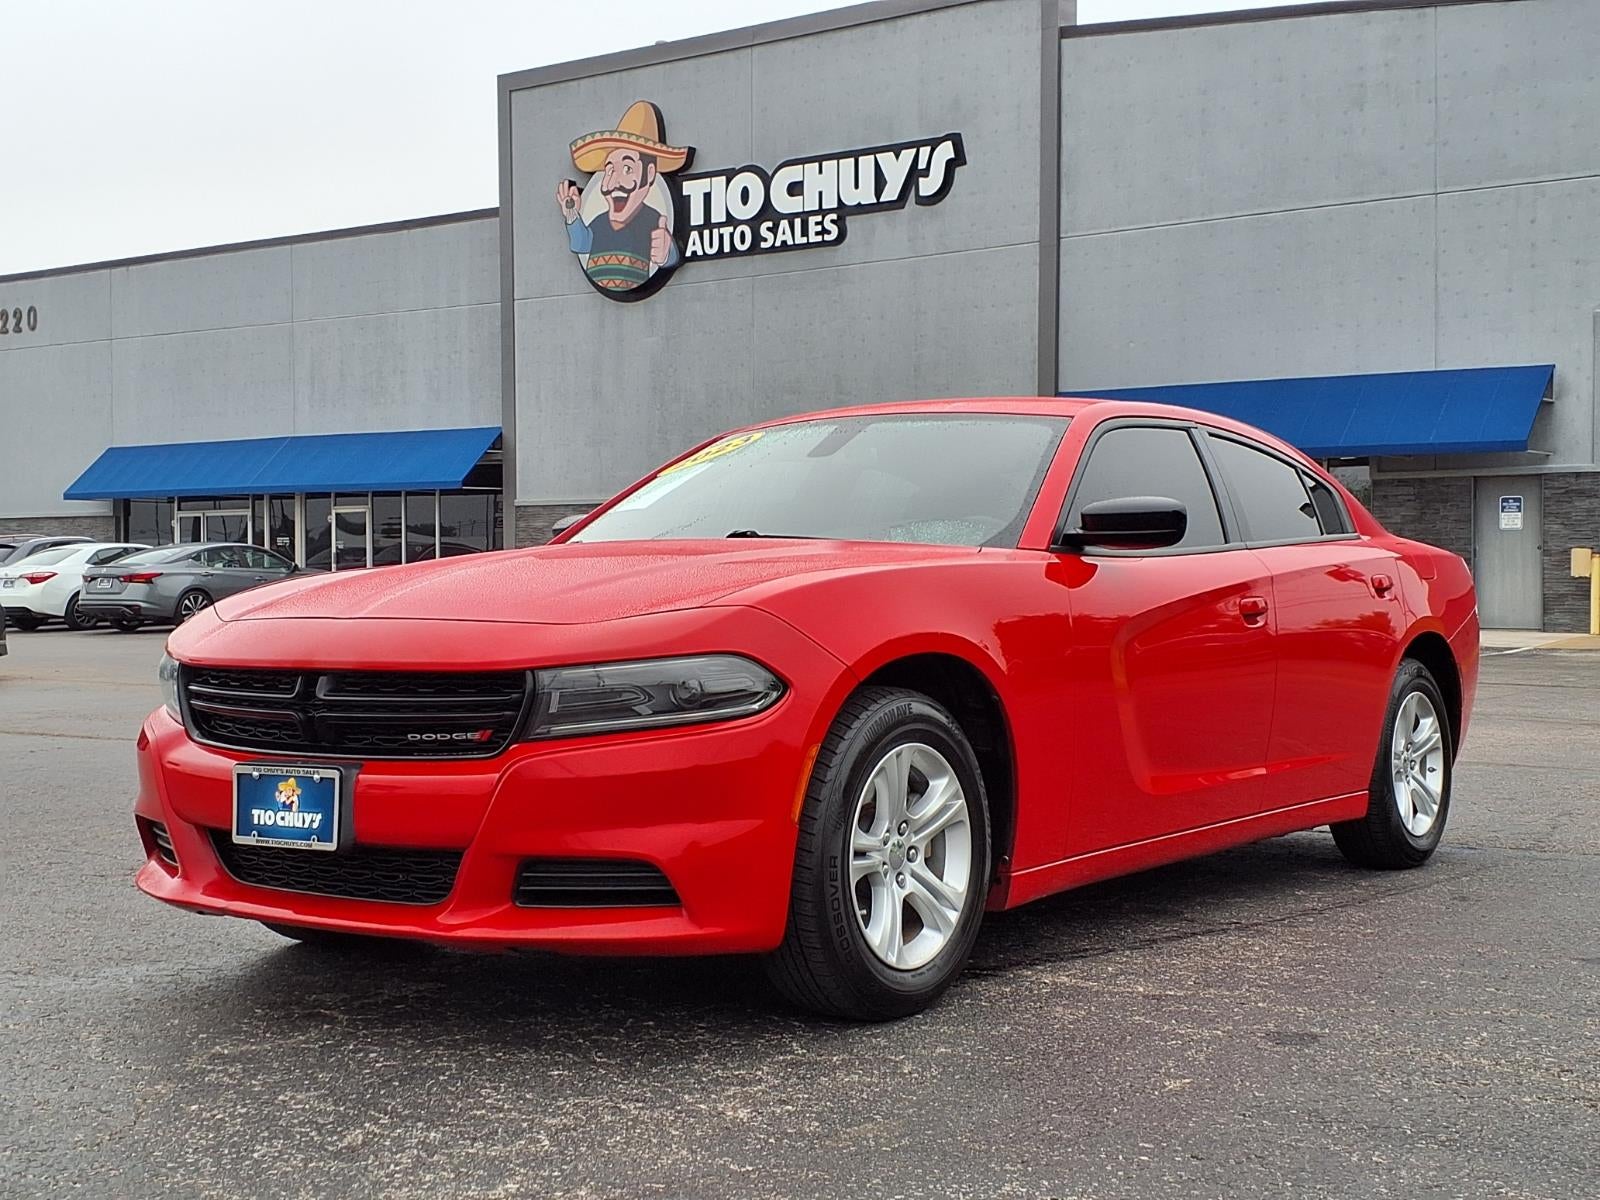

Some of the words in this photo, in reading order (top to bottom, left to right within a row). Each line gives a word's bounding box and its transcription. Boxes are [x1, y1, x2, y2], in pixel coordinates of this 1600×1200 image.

[683, 171, 765, 226] TIO
[770, 140, 955, 214] CHUY'S
[685, 226, 752, 257] AUTO
[760, 213, 839, 248] SALES
[407, 733, 480, 741] DODGE
[252, 809, 275, 826] TIO
[275, 811, 322, 829] CHUY'S
